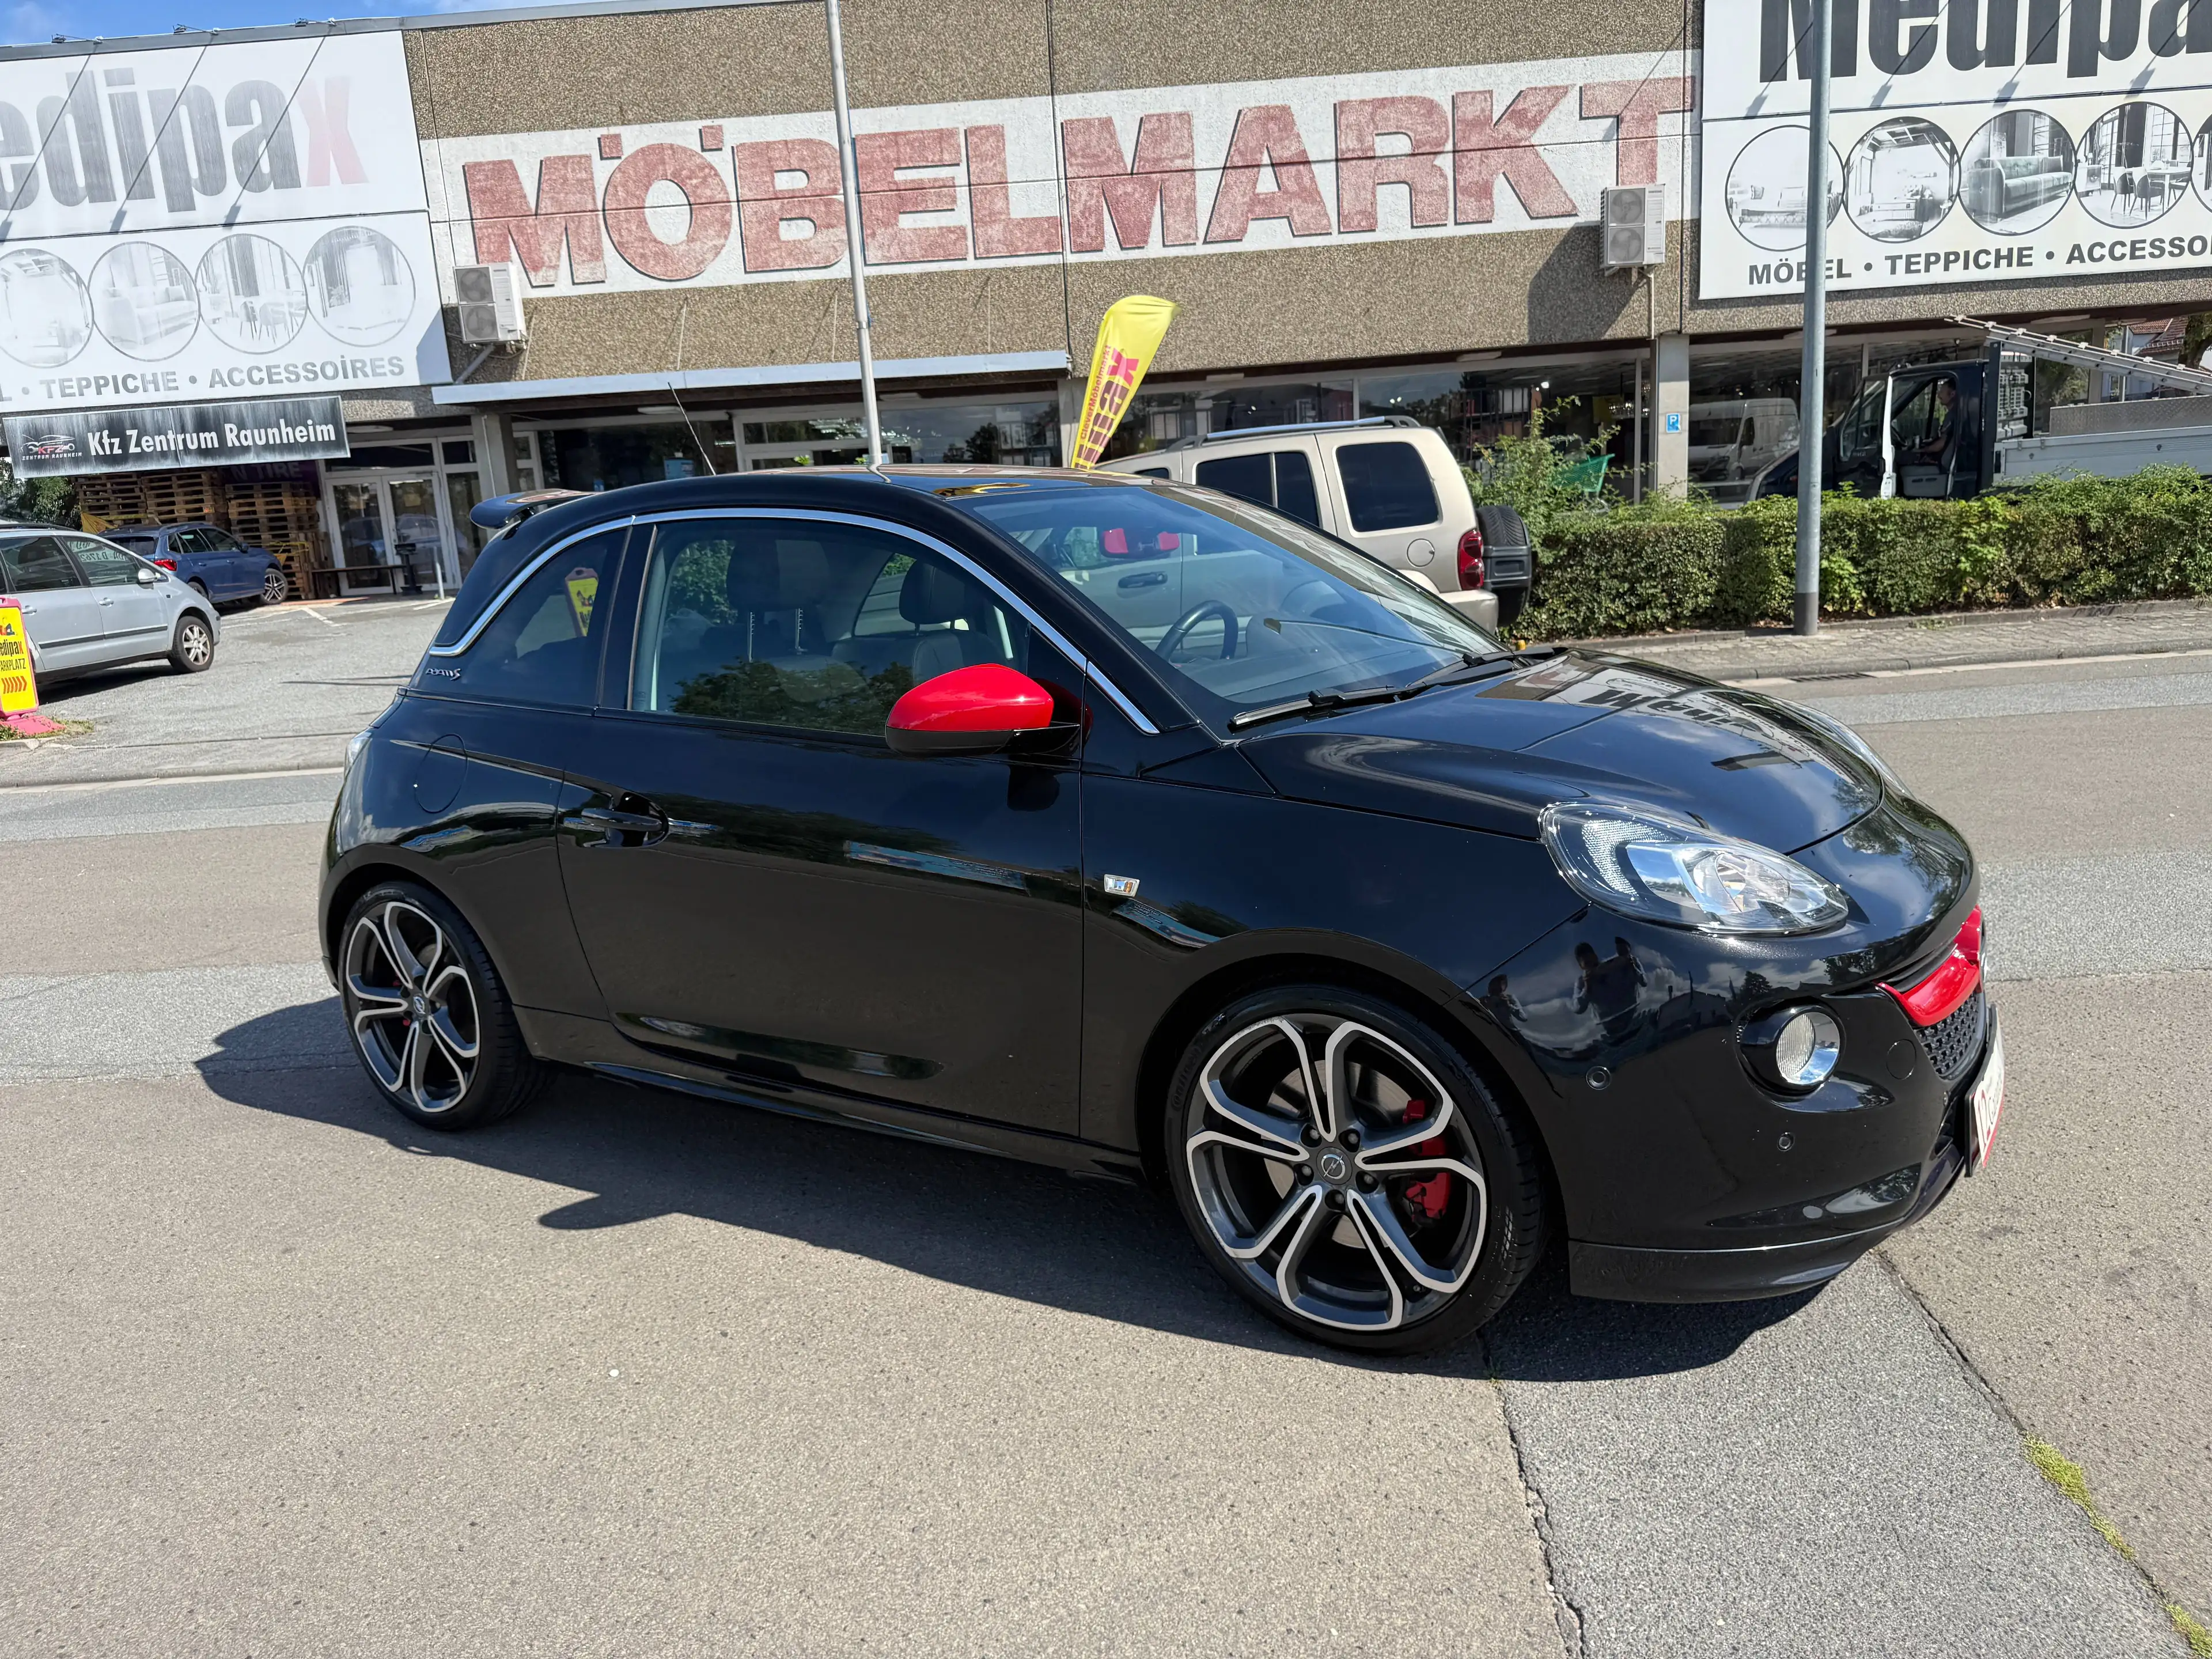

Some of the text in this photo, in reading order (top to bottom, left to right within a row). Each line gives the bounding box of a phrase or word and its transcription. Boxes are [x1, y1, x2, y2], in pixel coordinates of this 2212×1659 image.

[463, 75, 1695, 287] MÖBELMARKT
[1885, 246, 2033, 275] TEPPICHE
[2066, 234, 2212, 264] ACCESSO
[39, 372, 179, 399] TEPPICHE
[1670, 416, 1677, 425] P
[37, 444, 65, 454] KFZ
[88, 419, 336, 456] Kfz Zentrum Raunheim
[251, 461, 303, 480] TIRE
